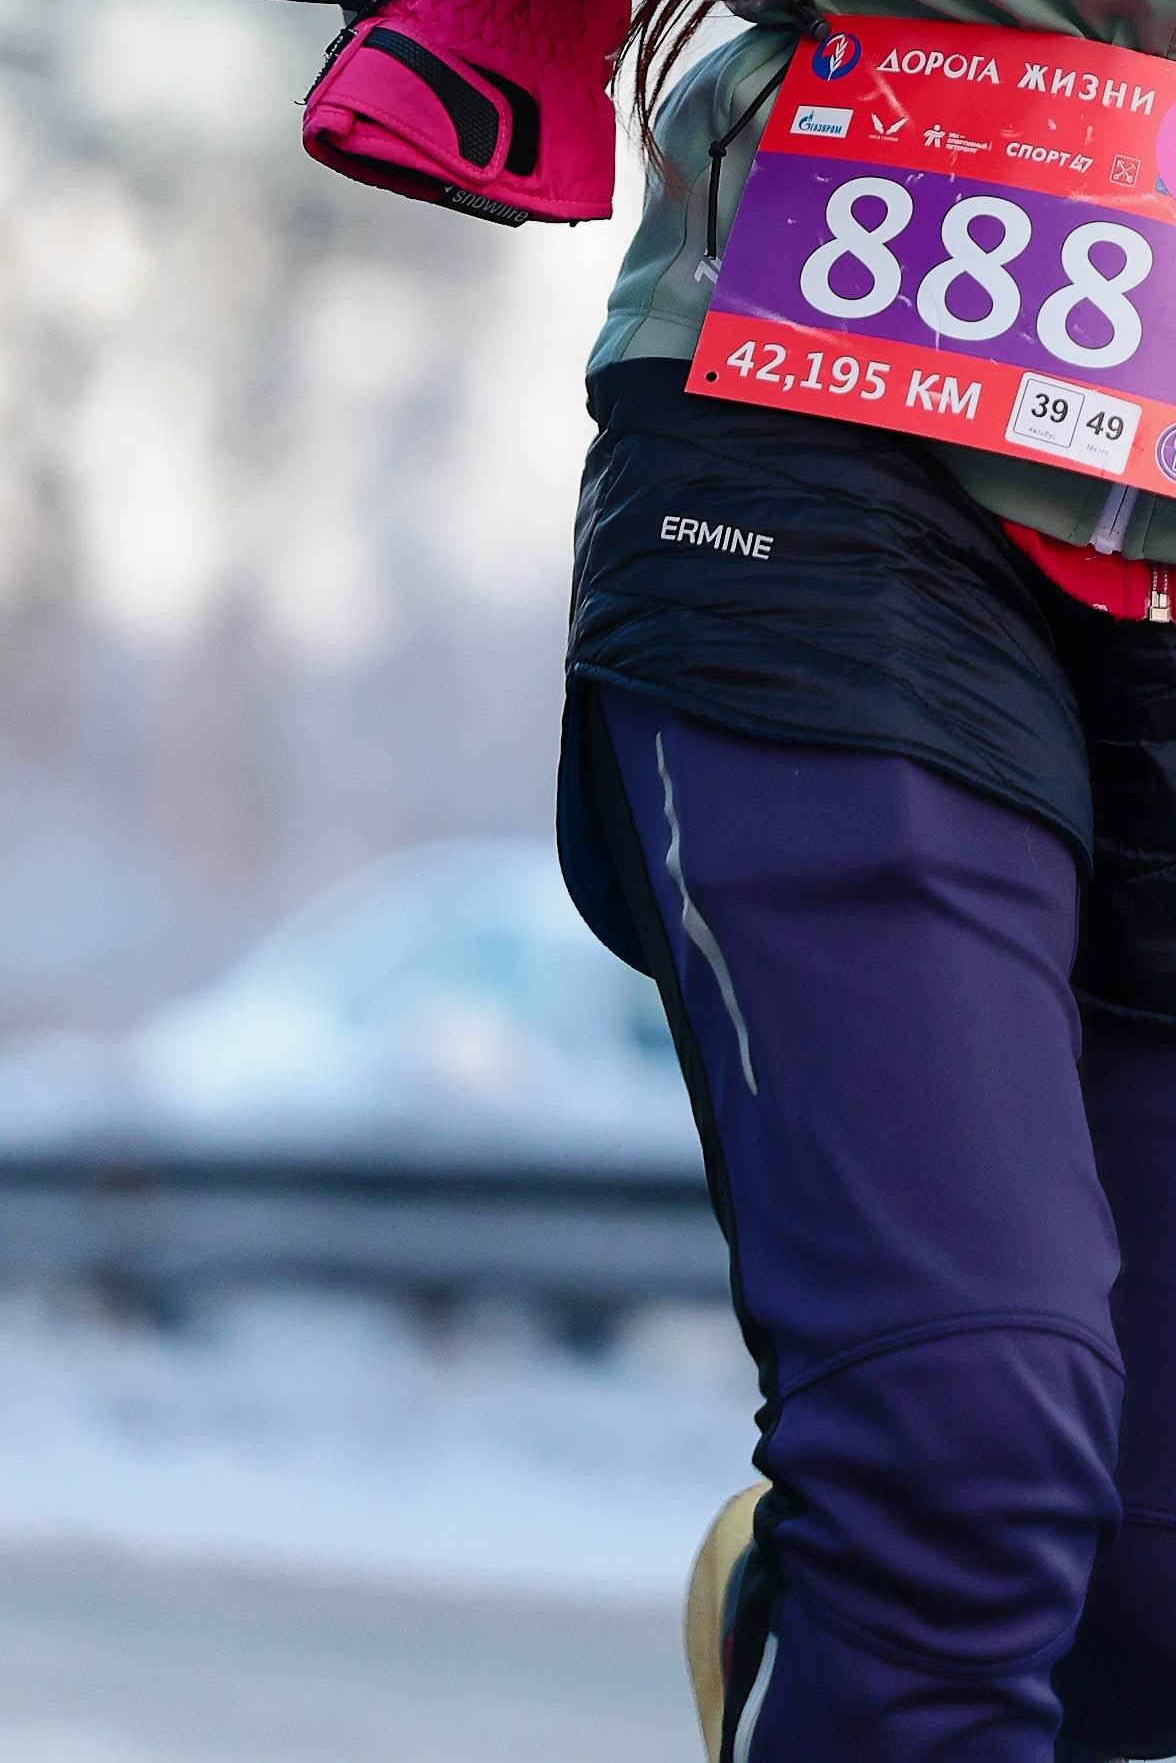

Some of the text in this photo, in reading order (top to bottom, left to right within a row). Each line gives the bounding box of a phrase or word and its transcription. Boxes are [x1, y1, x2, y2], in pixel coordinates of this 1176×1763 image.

[877, 48, 1156, 115] ДОРОГА ЖИЗНИ
[799, 175, 1153, 368] 888
[726, 339, 983, 420] 42,195 КМ
[1031, 392, 1069, 423] 39
[1085, 411, 1124, 441] 49
[660, 515, 775, 560] ERMINE
